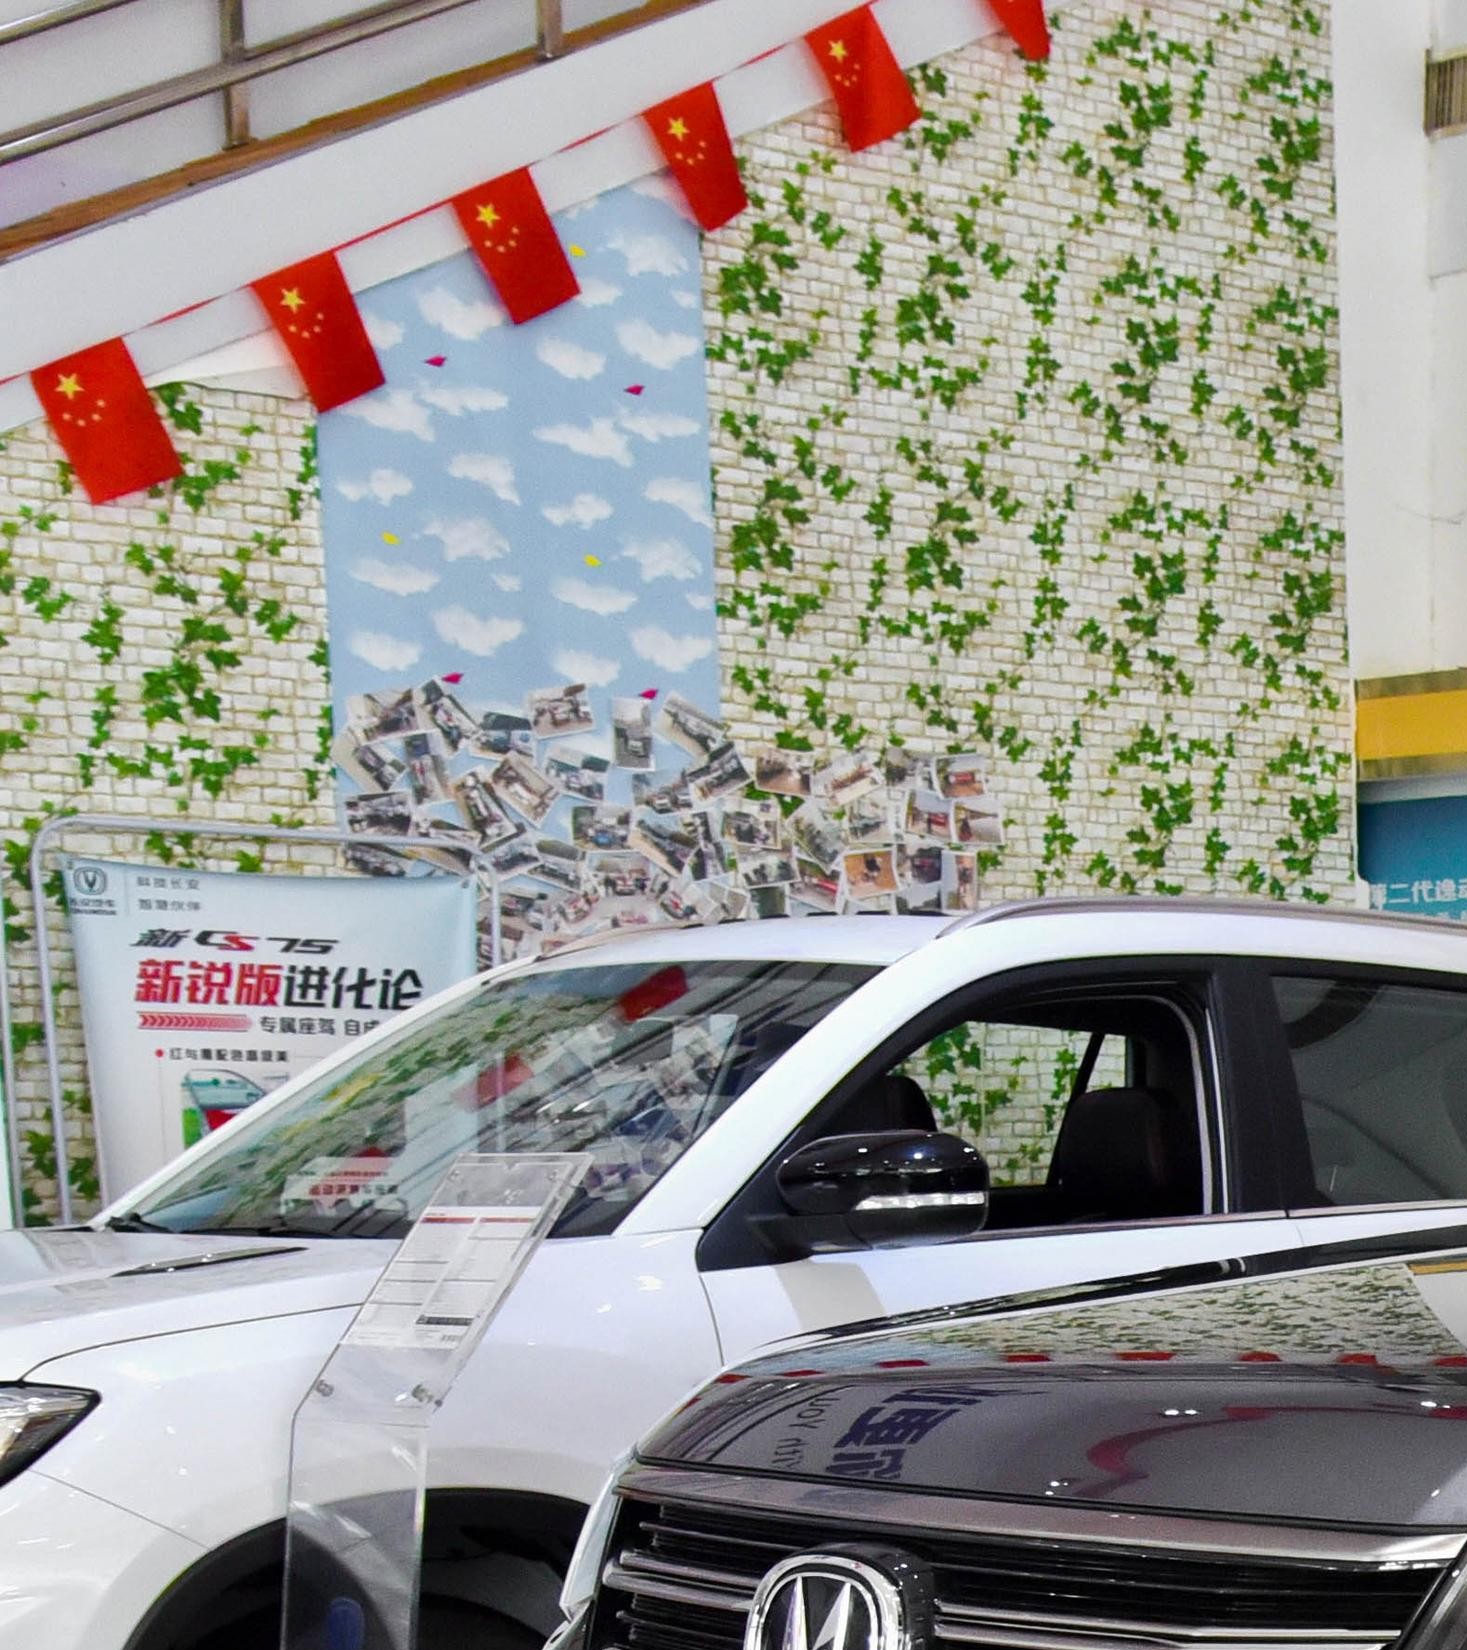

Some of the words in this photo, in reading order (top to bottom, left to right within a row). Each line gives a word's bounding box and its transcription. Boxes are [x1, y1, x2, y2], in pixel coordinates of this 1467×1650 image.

[134, 958, 423, 1010] 新锐版进化论
